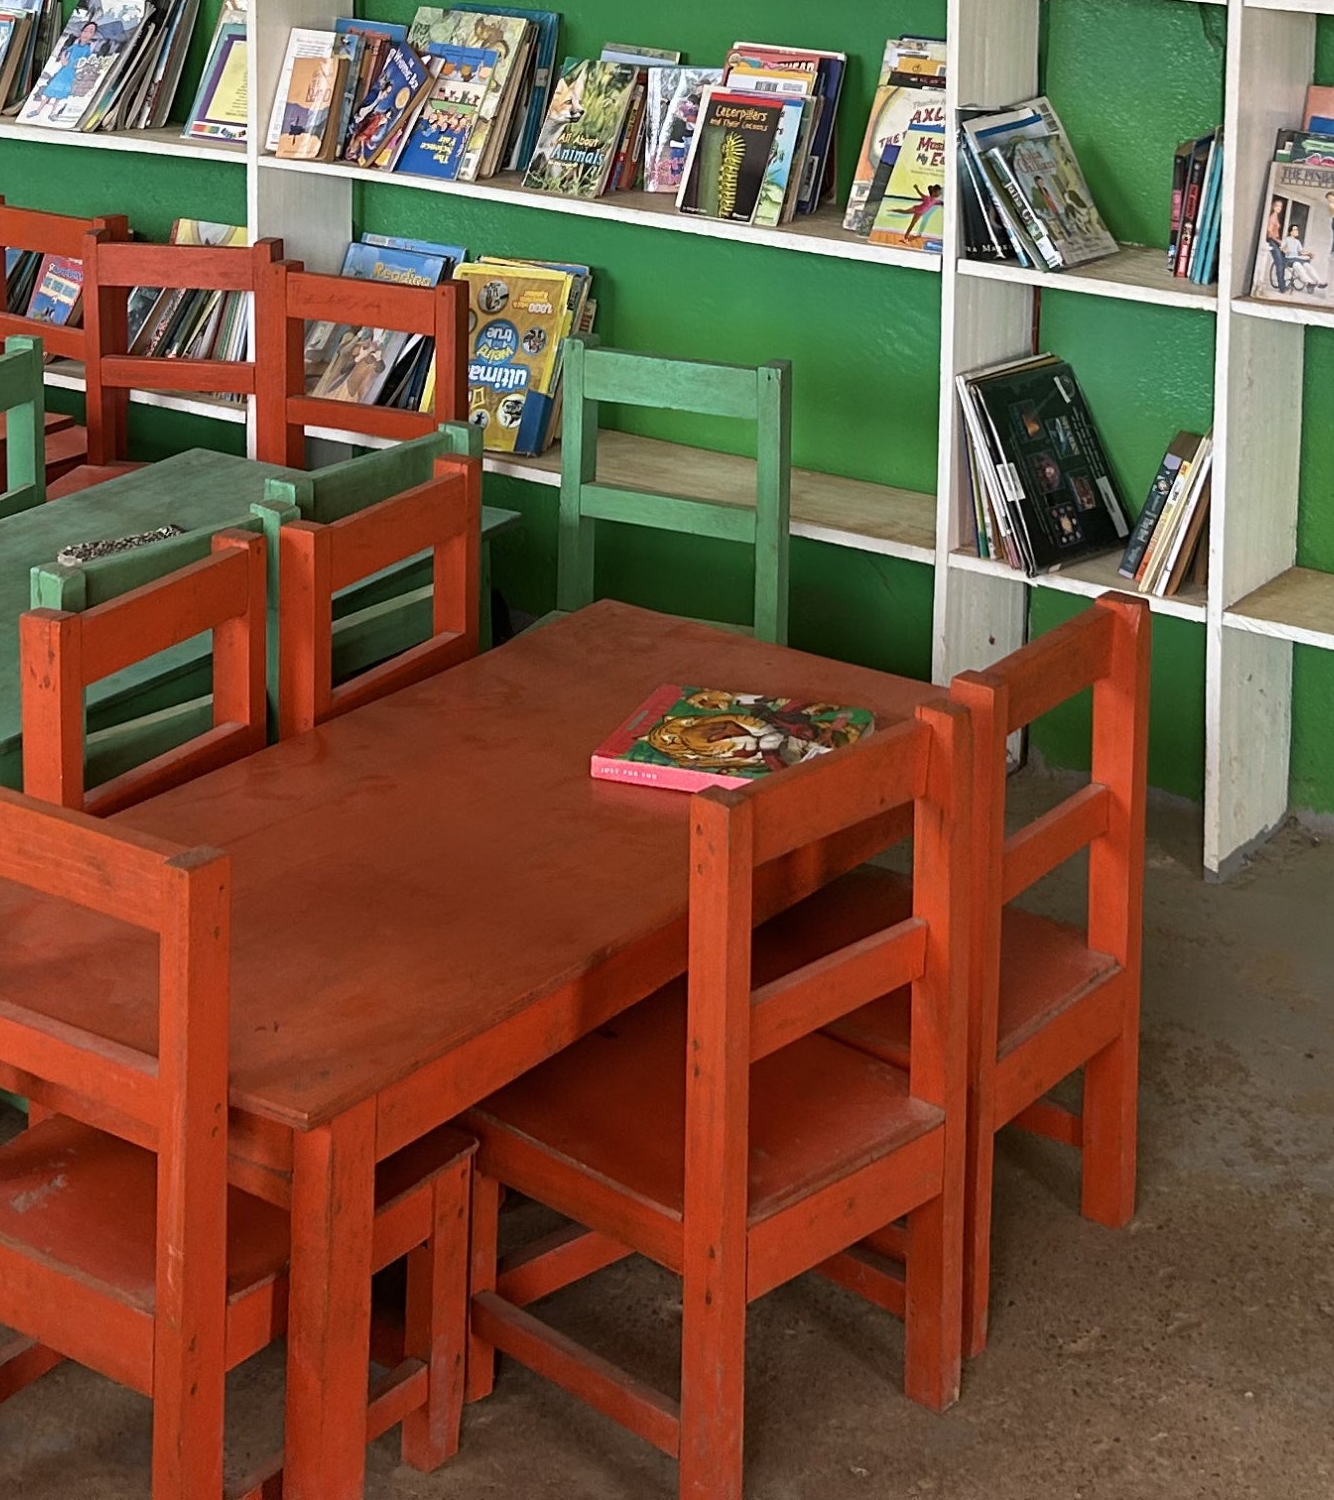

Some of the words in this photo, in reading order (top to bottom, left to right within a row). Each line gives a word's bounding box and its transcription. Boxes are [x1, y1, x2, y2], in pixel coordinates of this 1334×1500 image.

[715, 104, 768, 122] Caterpillars
[910, 106, 946, 123] AXL
[710, 117, 722, 126] and
[723, 117, 741, 129] Their
[558, 132, 572, 143] All
[573, 132, 599, 146] About
[879, 133, 901, 149] THE
[434, 153, 450, 164] The
[551, 144, 606, 166] Animals
[916, 152, 928, 166] My
[1282, 166, 1303, 181] THE
[487, 327, 513, 341] true
[476, 346, 515, 365] weird
[623, 770, 638, 778] FOR
[641, 772, 658, 780] YOU
